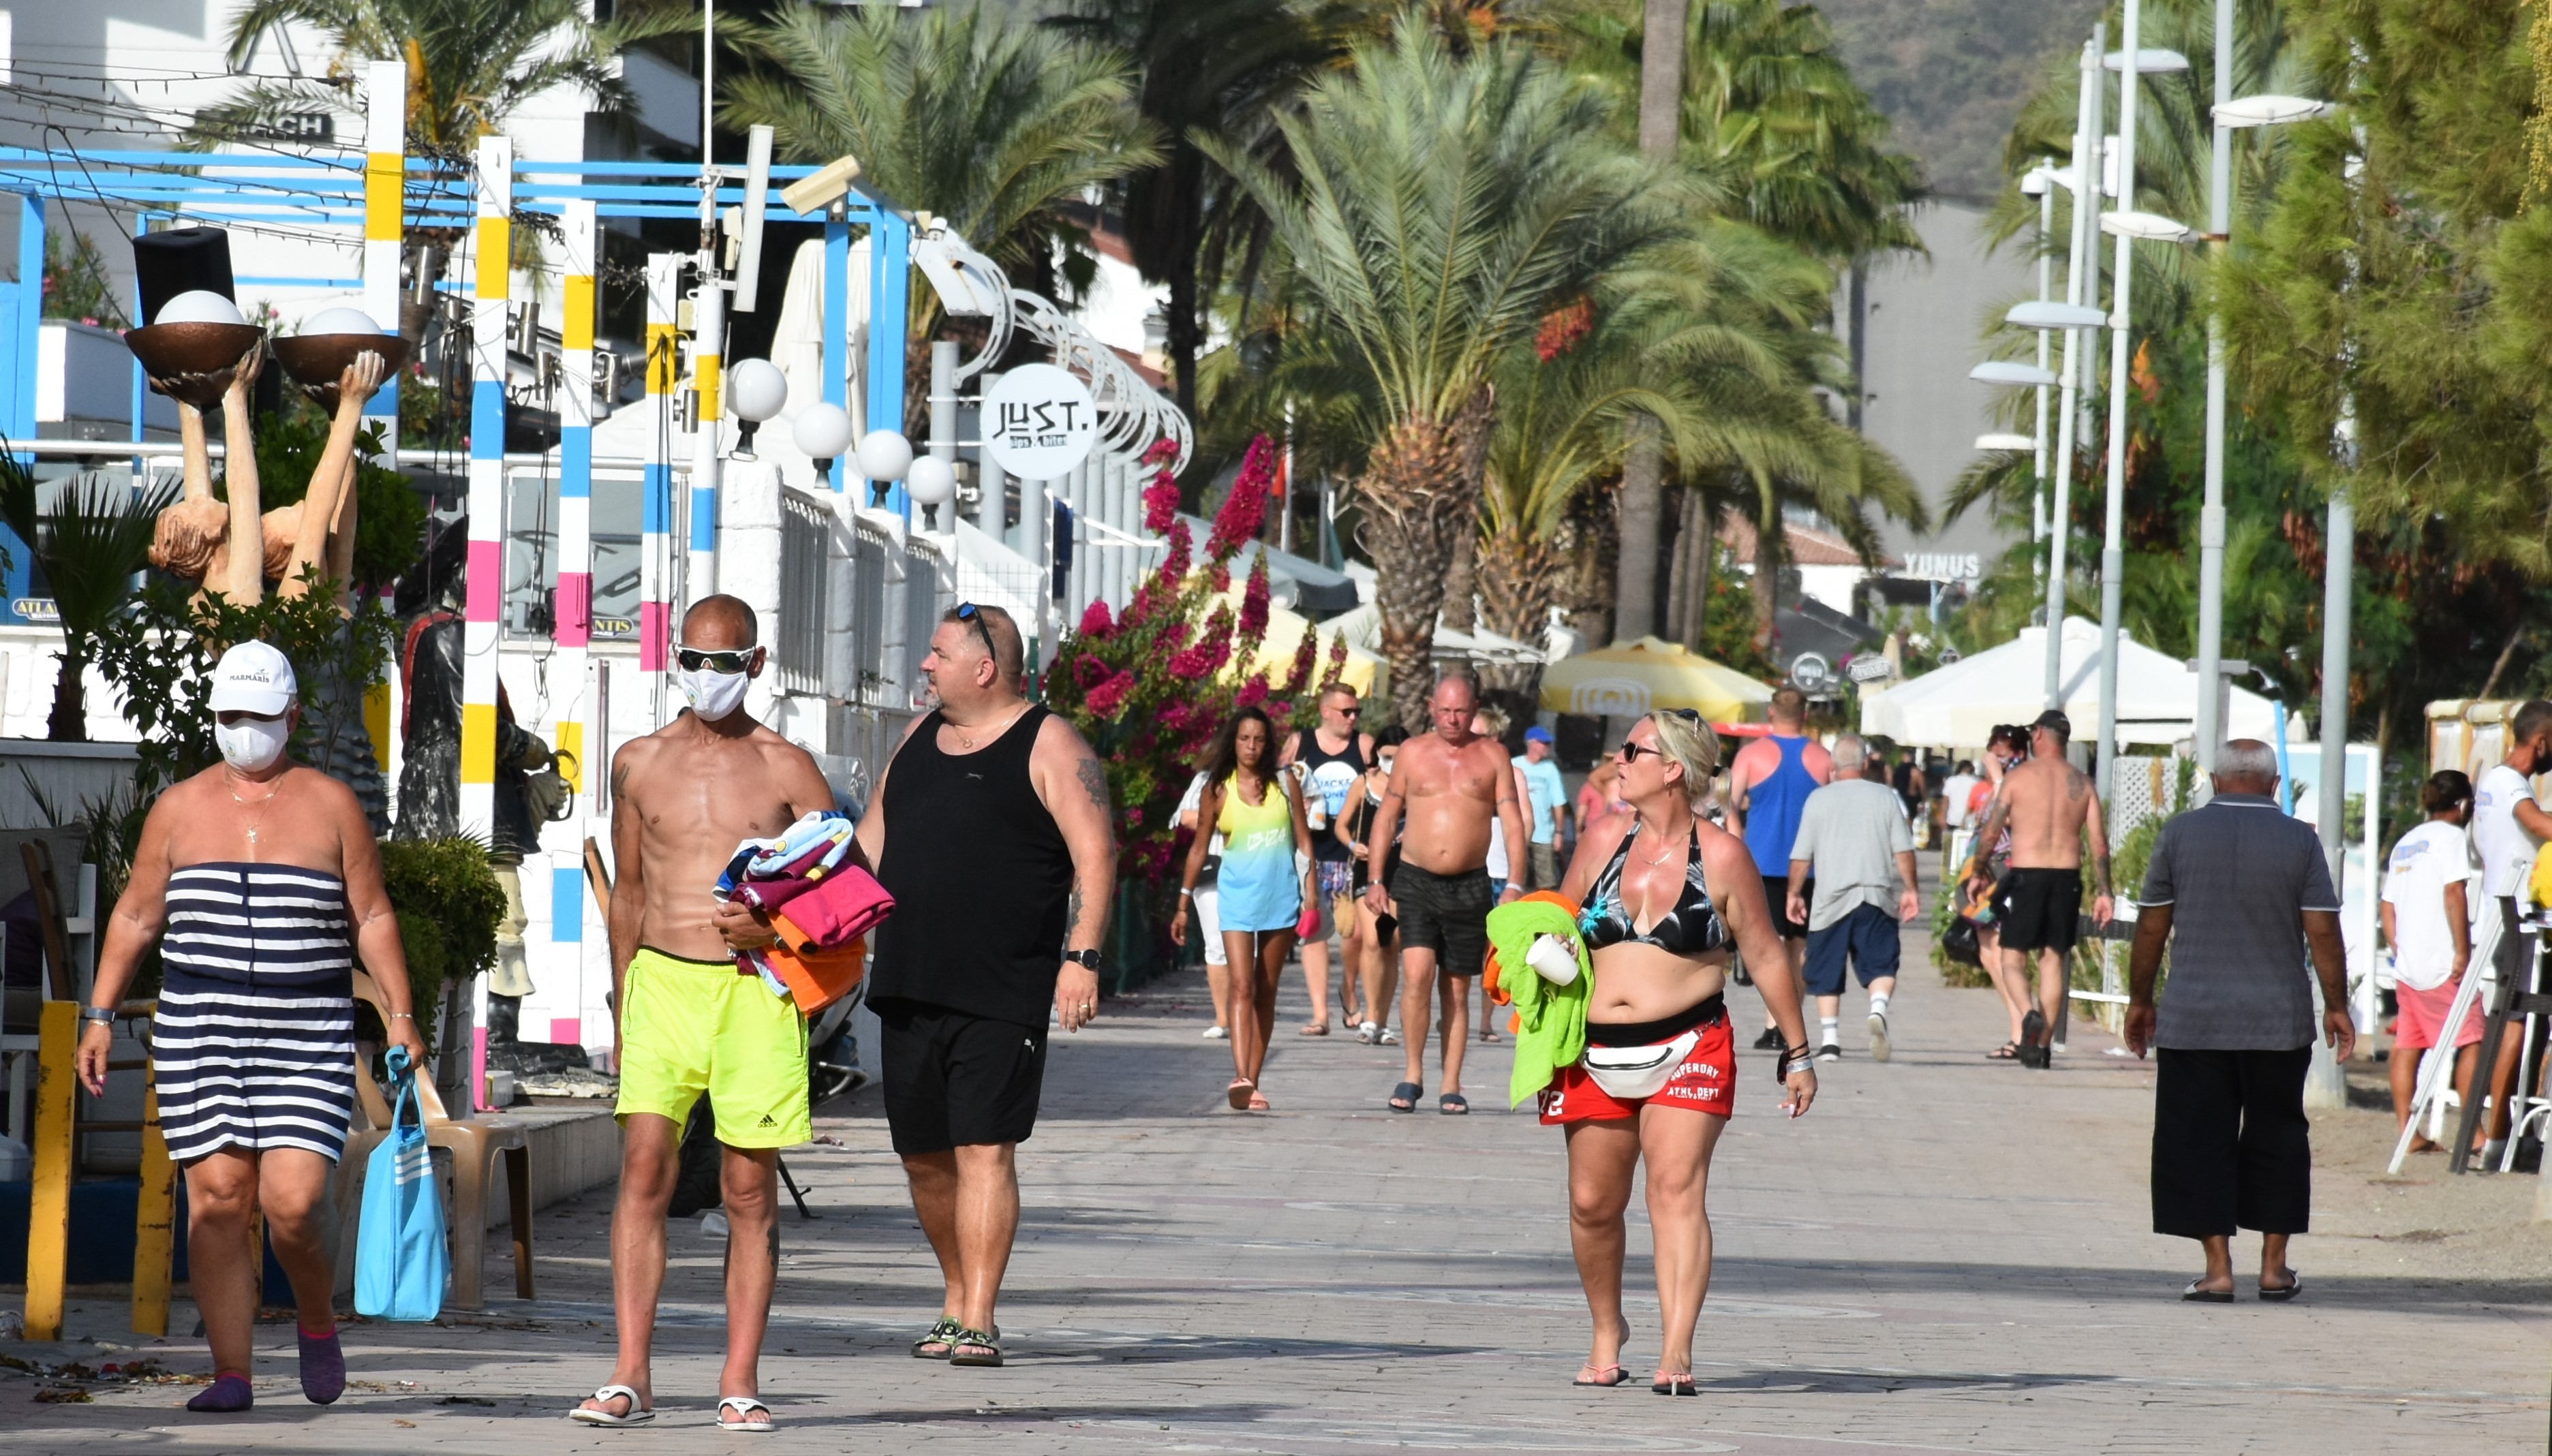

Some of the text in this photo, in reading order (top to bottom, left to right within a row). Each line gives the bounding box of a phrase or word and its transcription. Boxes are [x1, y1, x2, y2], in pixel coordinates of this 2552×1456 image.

[1903, 553, 1980, 578] YUNUS
[16, 601, 57, 613] ATLA
[594, 619, 630, 632] NTIS
[1697, 1087, 1719, 1098] DEPT
